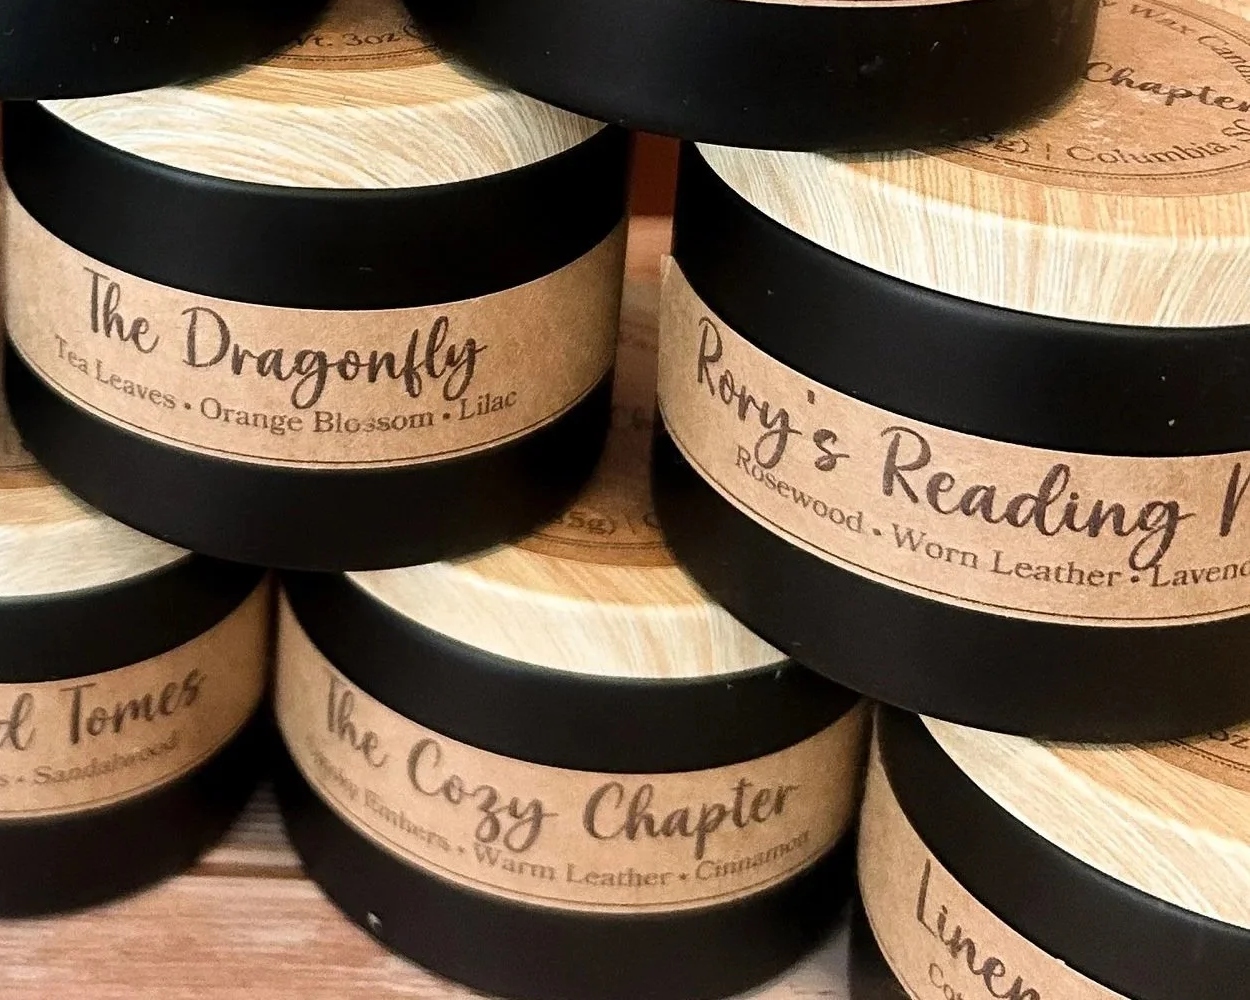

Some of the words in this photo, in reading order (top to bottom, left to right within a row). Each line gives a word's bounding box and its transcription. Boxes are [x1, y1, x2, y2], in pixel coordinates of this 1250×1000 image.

[1129, 4, 1197, 34] Wax
[53, 334, 90, 375] Tea
[94, 357, 177, 411] Leaves
[199, 397, 304, 435] Orange
[312, 408, 436, 435] Blossom
[458, 388, 518, 422] Lilac
[82, 266, 161, 354] The
[181, 306, 488, 410] Dragonfly
[696, 316, 851, 473] Rory's
[879, 424, 1197, 572] Reading
[734, 444, 867, 536] Rosewood
[891, 523, 979, 570] Worn
[992, 548, 1123, 588] Leather
[61, 667, 209, 746] Tomes
[323, 668, 390, 769] The
[406, 736, 557, 853] Cozy
[583, 777, 801, 860] Chapter
[474, 842, 556, 884] Warm
[566, 862, 670, 889] Leather
[695, 828, 811, 883] Cinnamon
